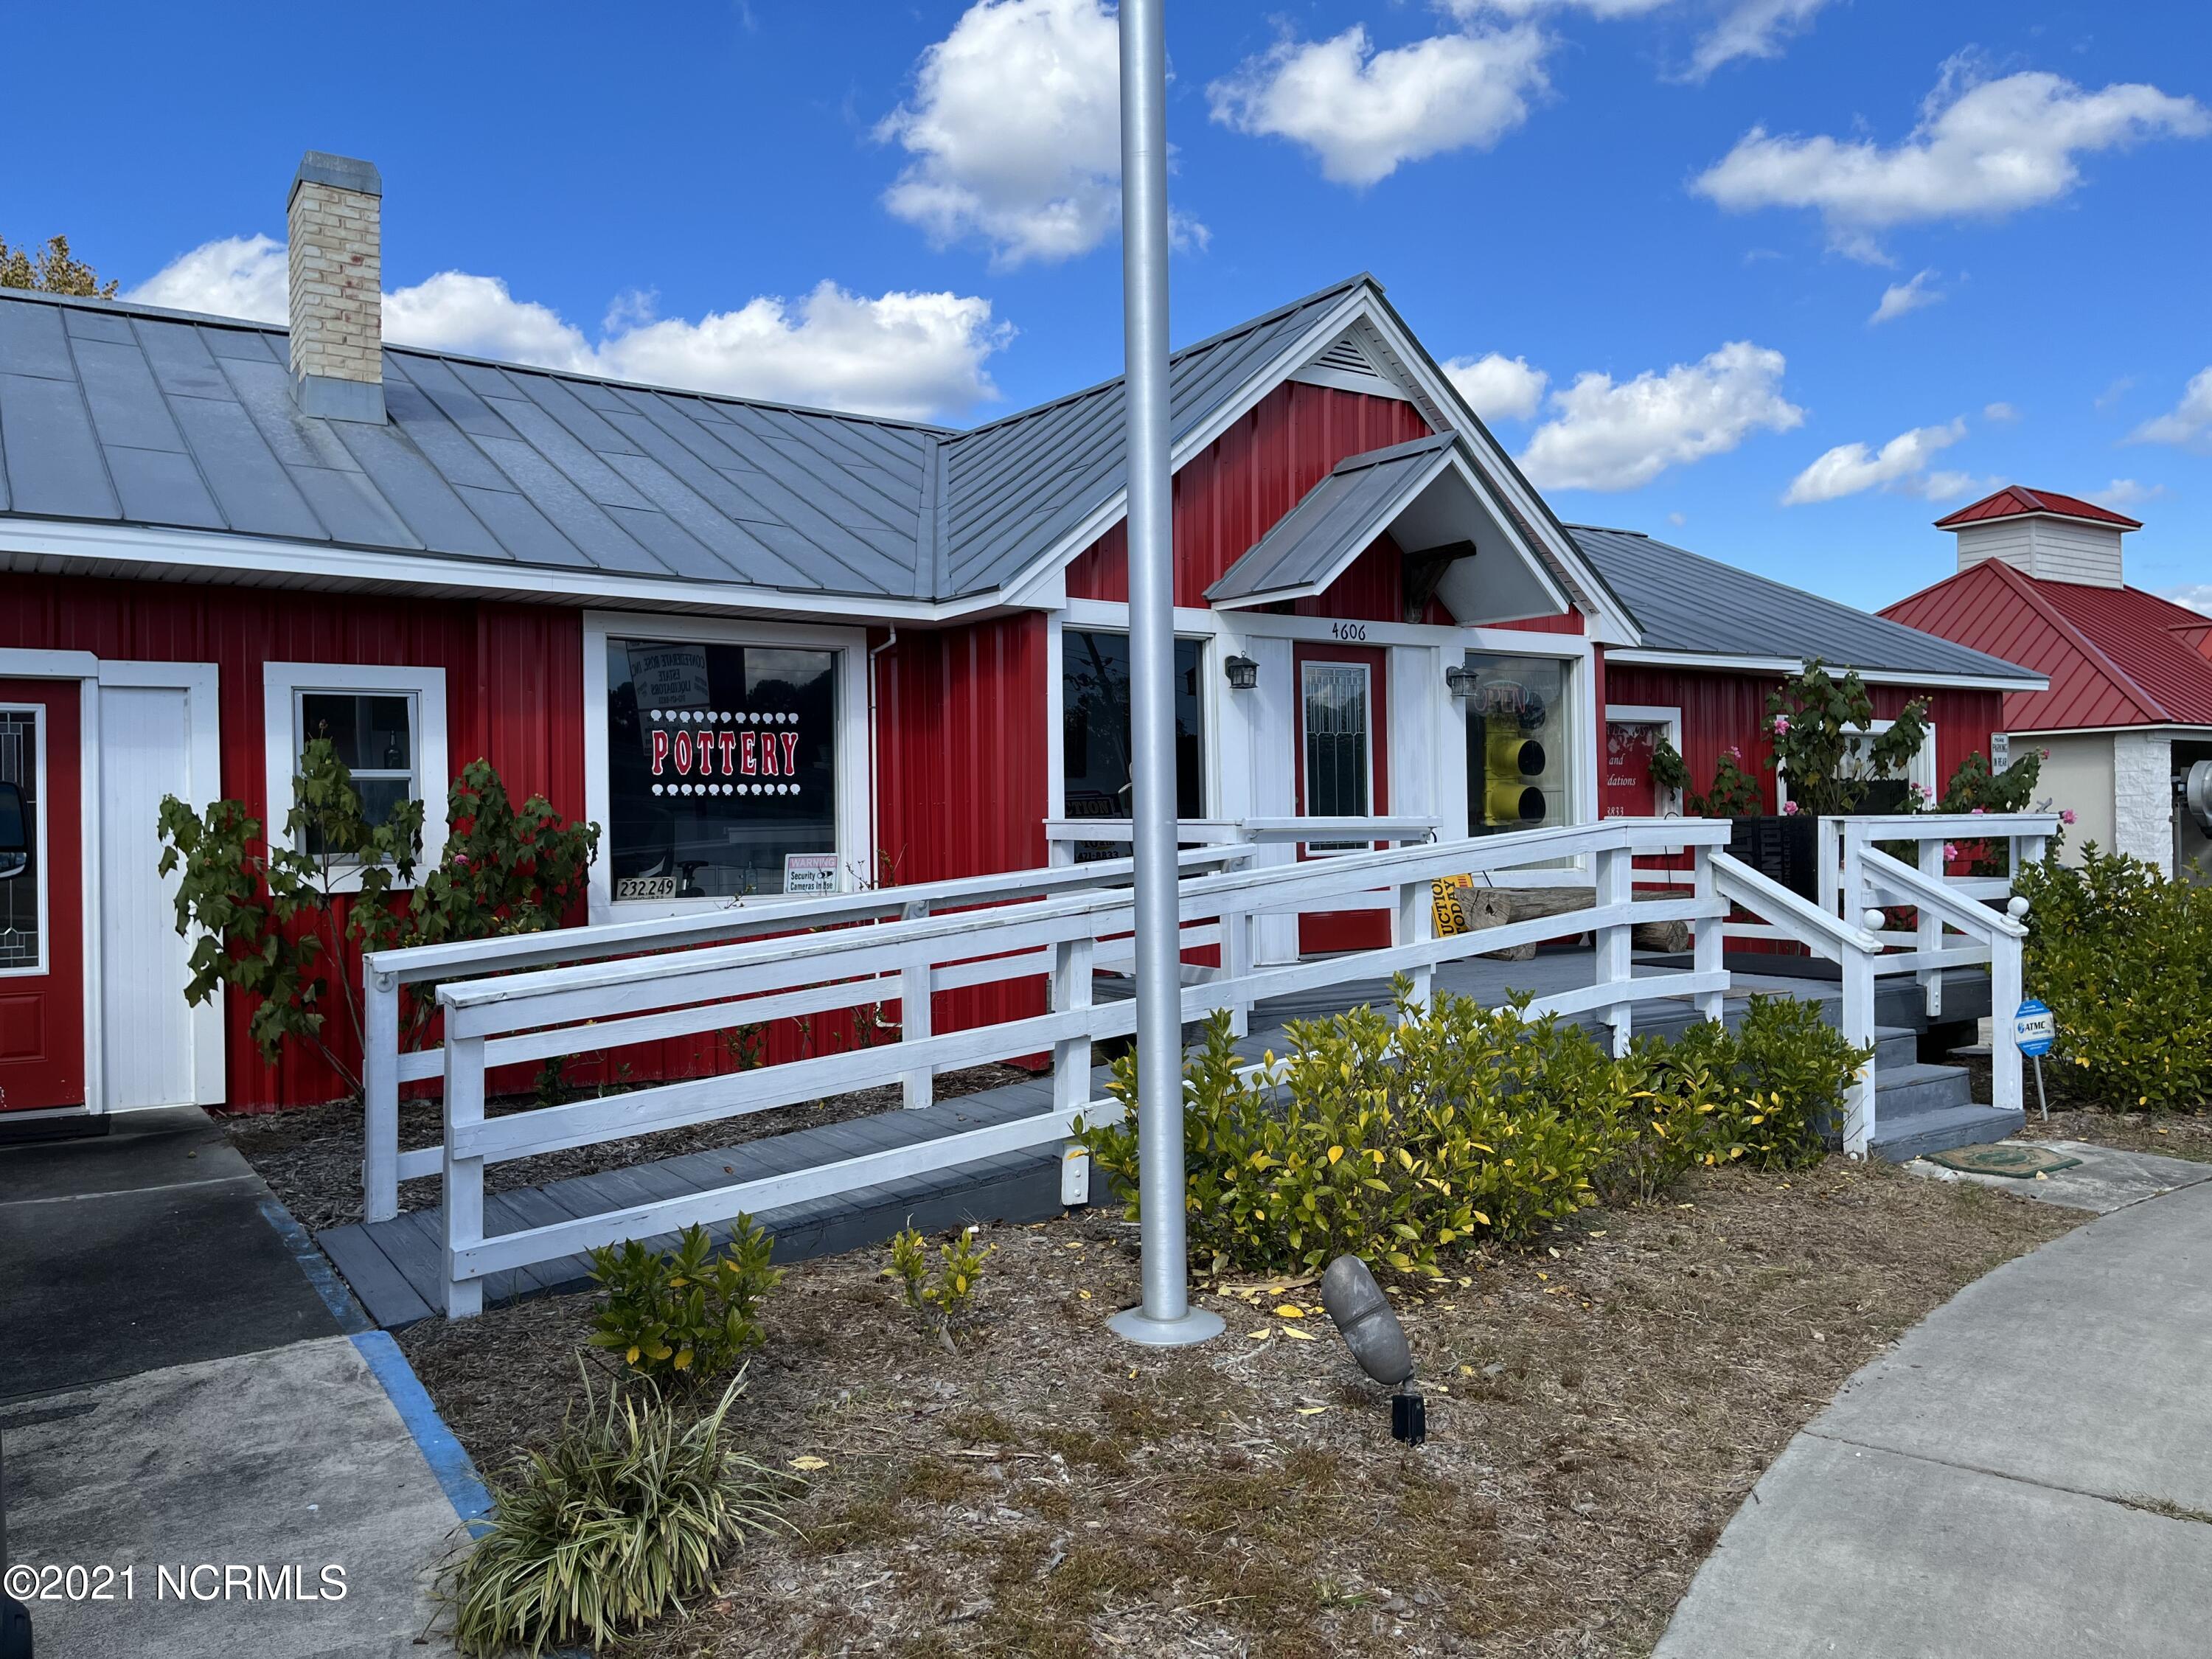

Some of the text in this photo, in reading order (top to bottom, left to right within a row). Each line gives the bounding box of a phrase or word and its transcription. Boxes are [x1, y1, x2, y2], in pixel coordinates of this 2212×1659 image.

[1332, 622, 1366, 641] 4606
[1474, 686, 1526, 714] OPEN
[652, 730, 799, 776] POTTERY
[1609, 753, 1625, 765] and
[791, 857, 836, 868] WARNING
[790, 872, 815, 881] Security
[790, 881, 833, 891] Cameras In Use
[2025, 1020, 2045, 1032] ATMC
